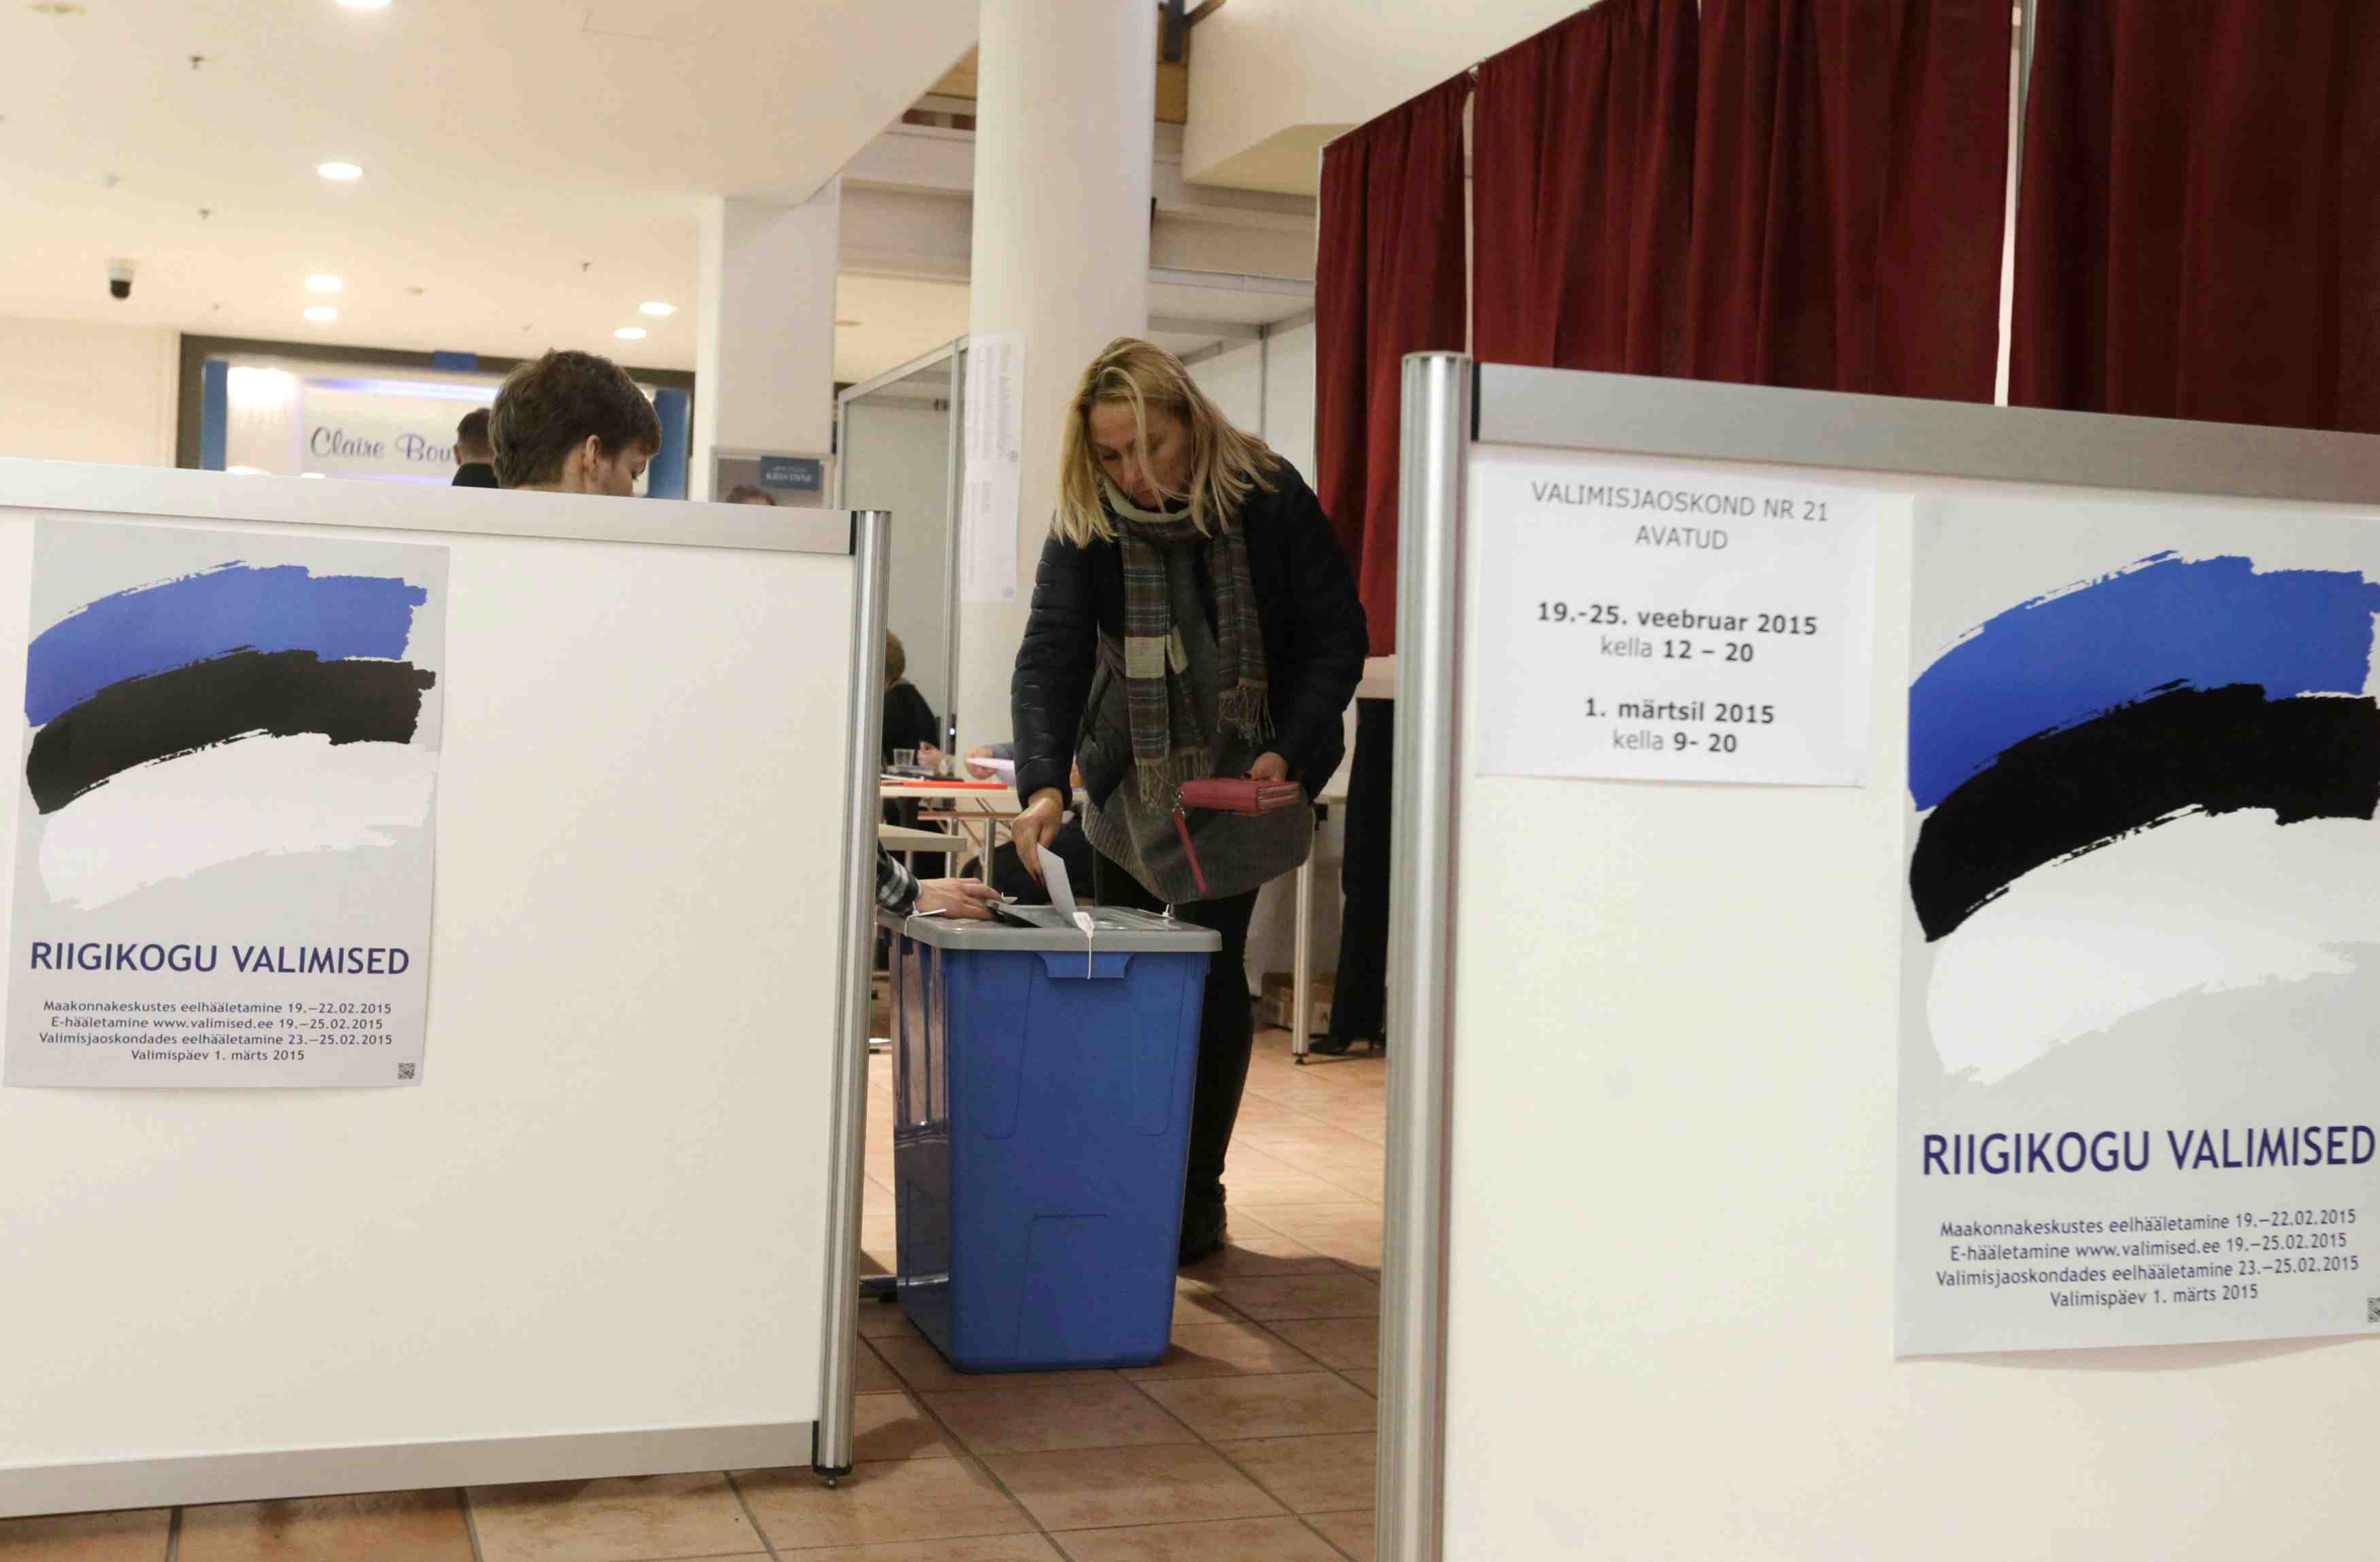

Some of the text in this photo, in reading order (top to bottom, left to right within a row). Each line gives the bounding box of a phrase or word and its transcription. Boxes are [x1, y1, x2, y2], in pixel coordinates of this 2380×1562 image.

[310, 426, 452, 462] Claire Bou
[1531, 481, 1828, 522] VALIMISJAOSKOND NR 21
[1635, 524, 1729, 550] AVATUD
[1635, 607, 1750, 633] veebruar
[1755, 613, 1818, 636] 2015
[1599, 634, 1653, 658] kella
[1662, 639, 1693, 661] 12
[1724, 641, 1755, 664] 20
[1584, 696, 1775, 725] 1. märtsil 2015
[1612, 728, 1665, 751] kella
[1707, 732, 1738, 754] 20
[31, 941, 409, 975] RIIGIKOGU VALIMISED
[44, 1000, 177, 1013] Maakonnakeskustes
[180, 1001, 283, 1013] eelhääletamine
[51, 1016, 150, 1029] E-hääletamine
[152, 1017, 274, 1030] www.valimised.ee
[39, 1031, 178, 1046] Valimisjaoskondades
[181, 1034, 283, 1045] eelhääletamine
[131, 1048, 305, 1063] Valimispäev 1. märts 2015
[1922, 1125, 2377, 1176] RIIGIKOGU VALIMISED
[1940, 1219, 2104, 1237] Maakonnakeskustes
[2109, 1215, 2230, 1233] eelhääletamine
[1950, 1243, 2070, 1262] E-hääletamine
[2075, 1238, 2222, 1257] www.valimised.ee
[1936, 1266, 2107, 1289] Valimisjaoskondades
[2111, 1262, 2234, 1281] eelhääletamine
[2050, 1284, 2258, 1310] Valimispäev 1. märts 2015
